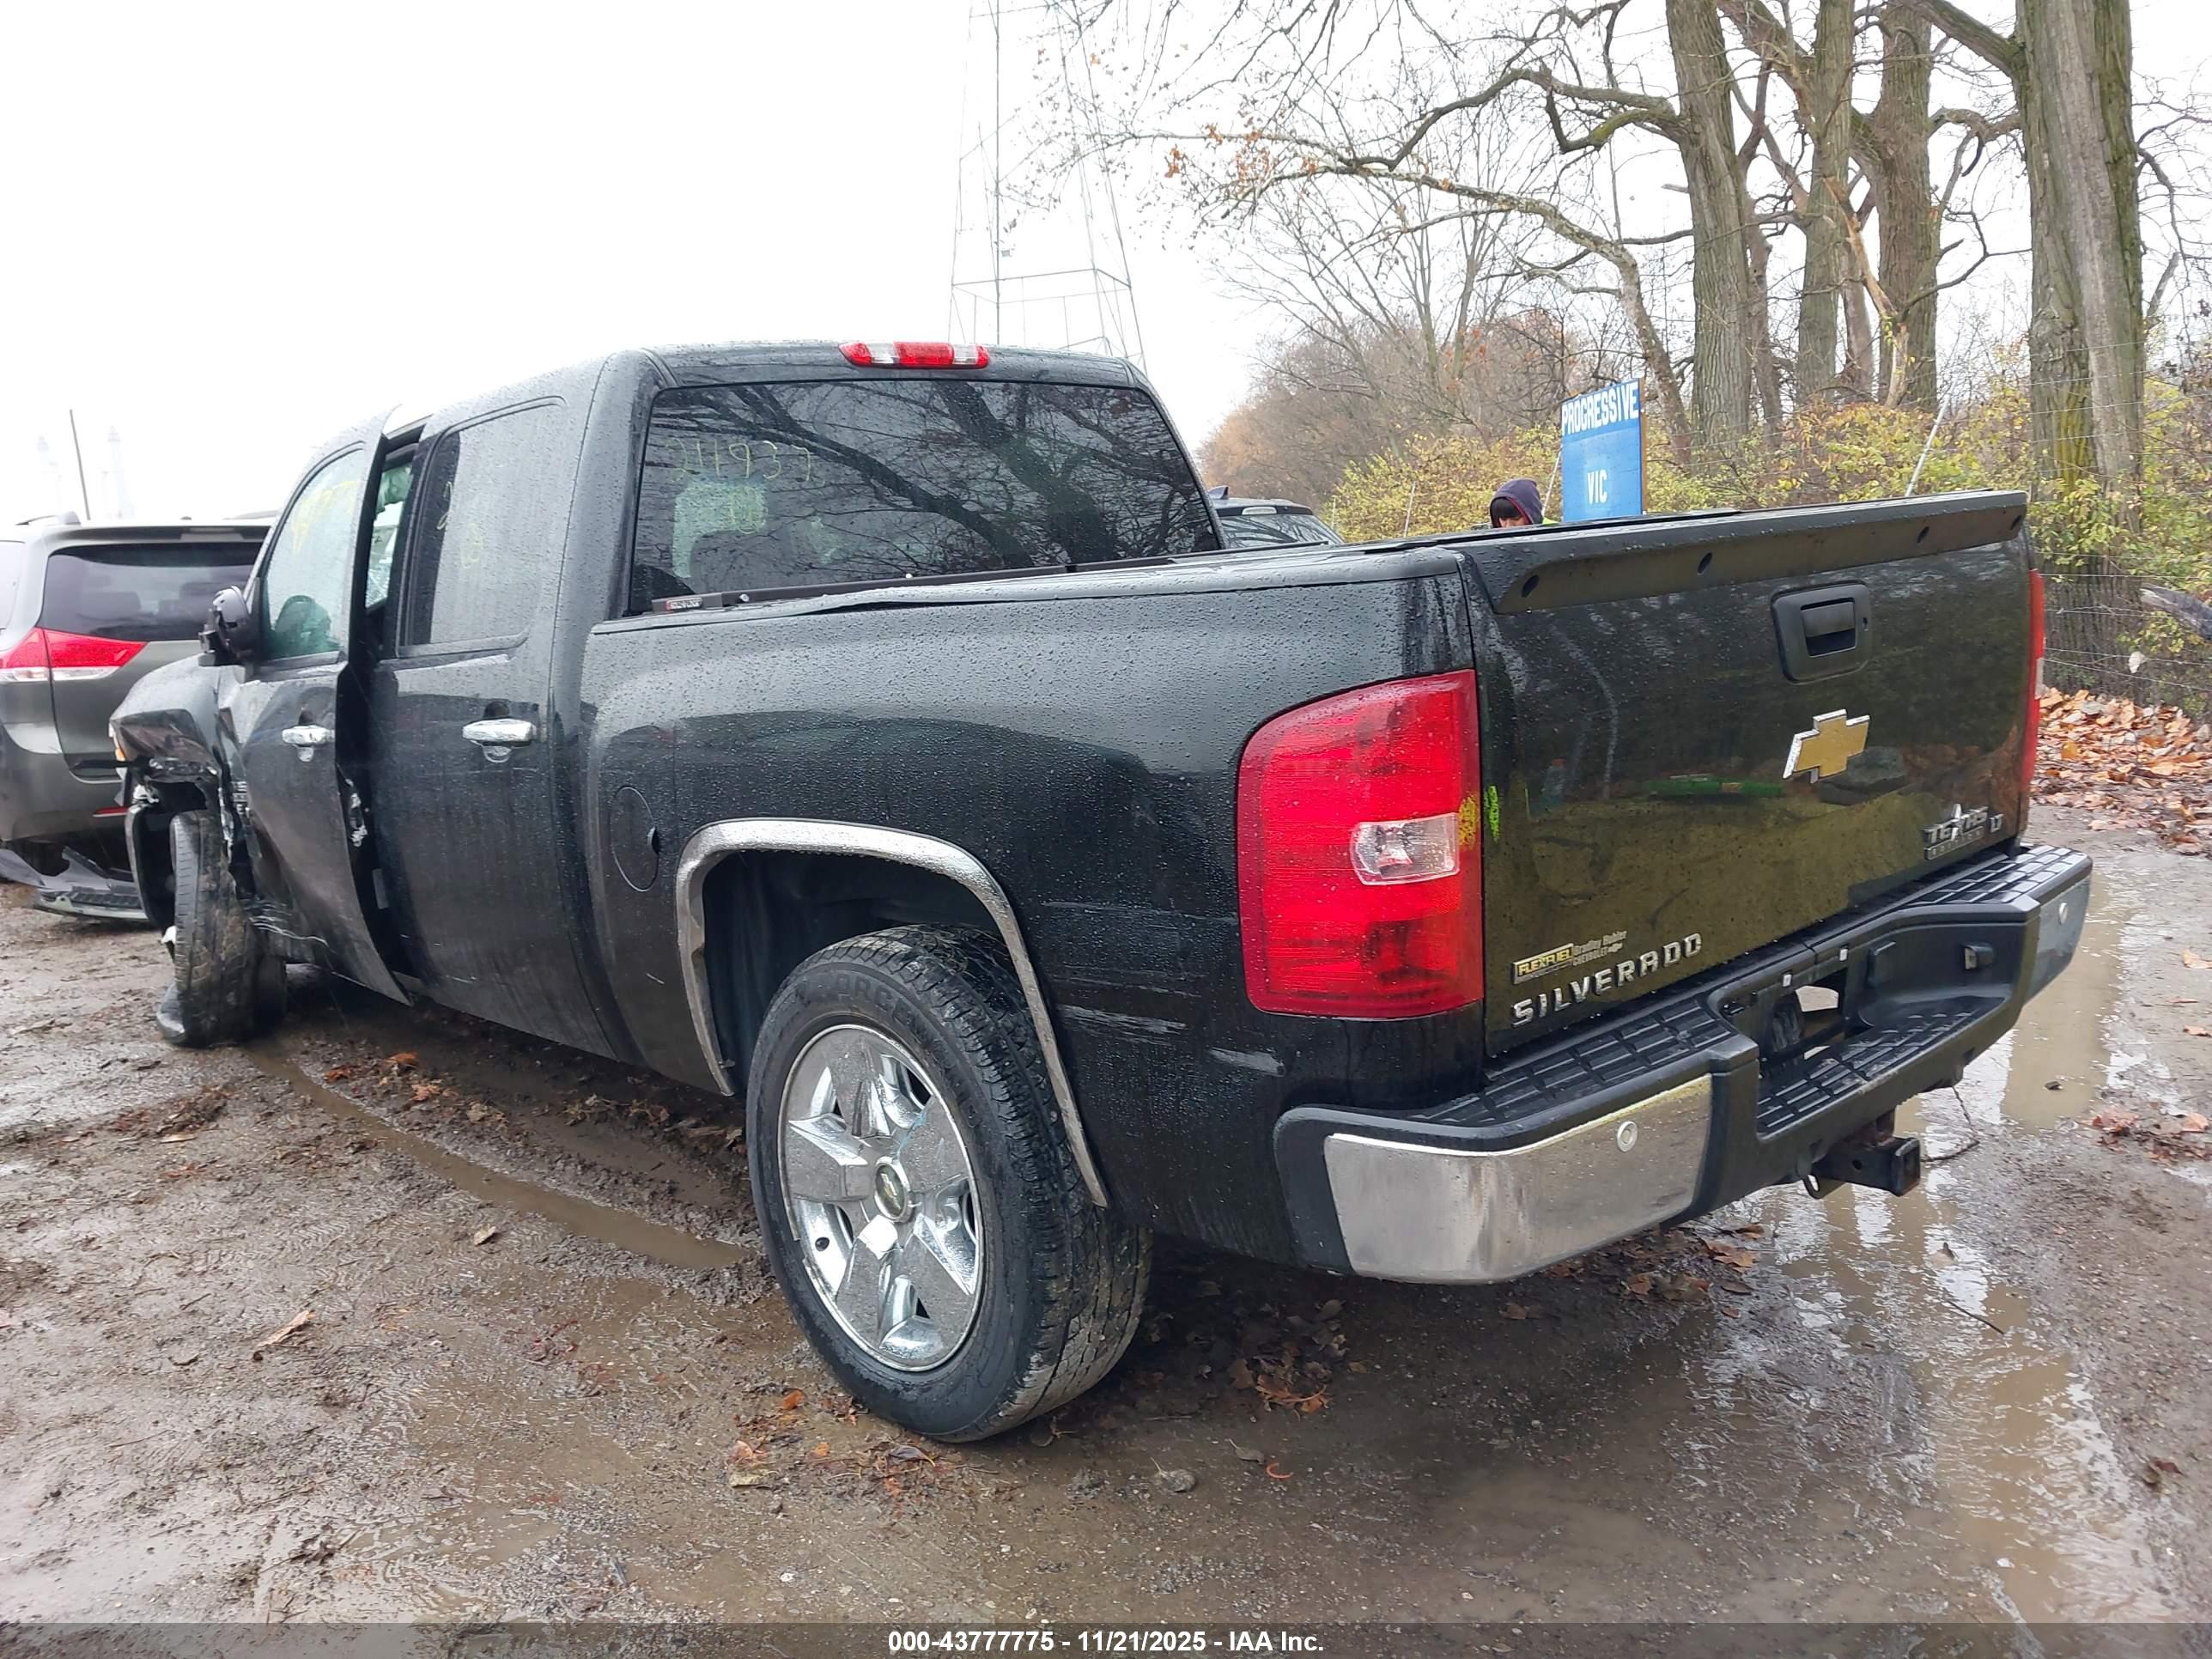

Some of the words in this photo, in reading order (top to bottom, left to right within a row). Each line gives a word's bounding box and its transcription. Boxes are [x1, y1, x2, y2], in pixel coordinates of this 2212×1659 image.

[1561, 380, 1639, 435] PROGRESSIVE
[1587, 469, 1608, 504] VIC
[1511, 933, 1703, 1027] SILVERADO
[1518, 948, 1572, 976] FLEXFUEL
